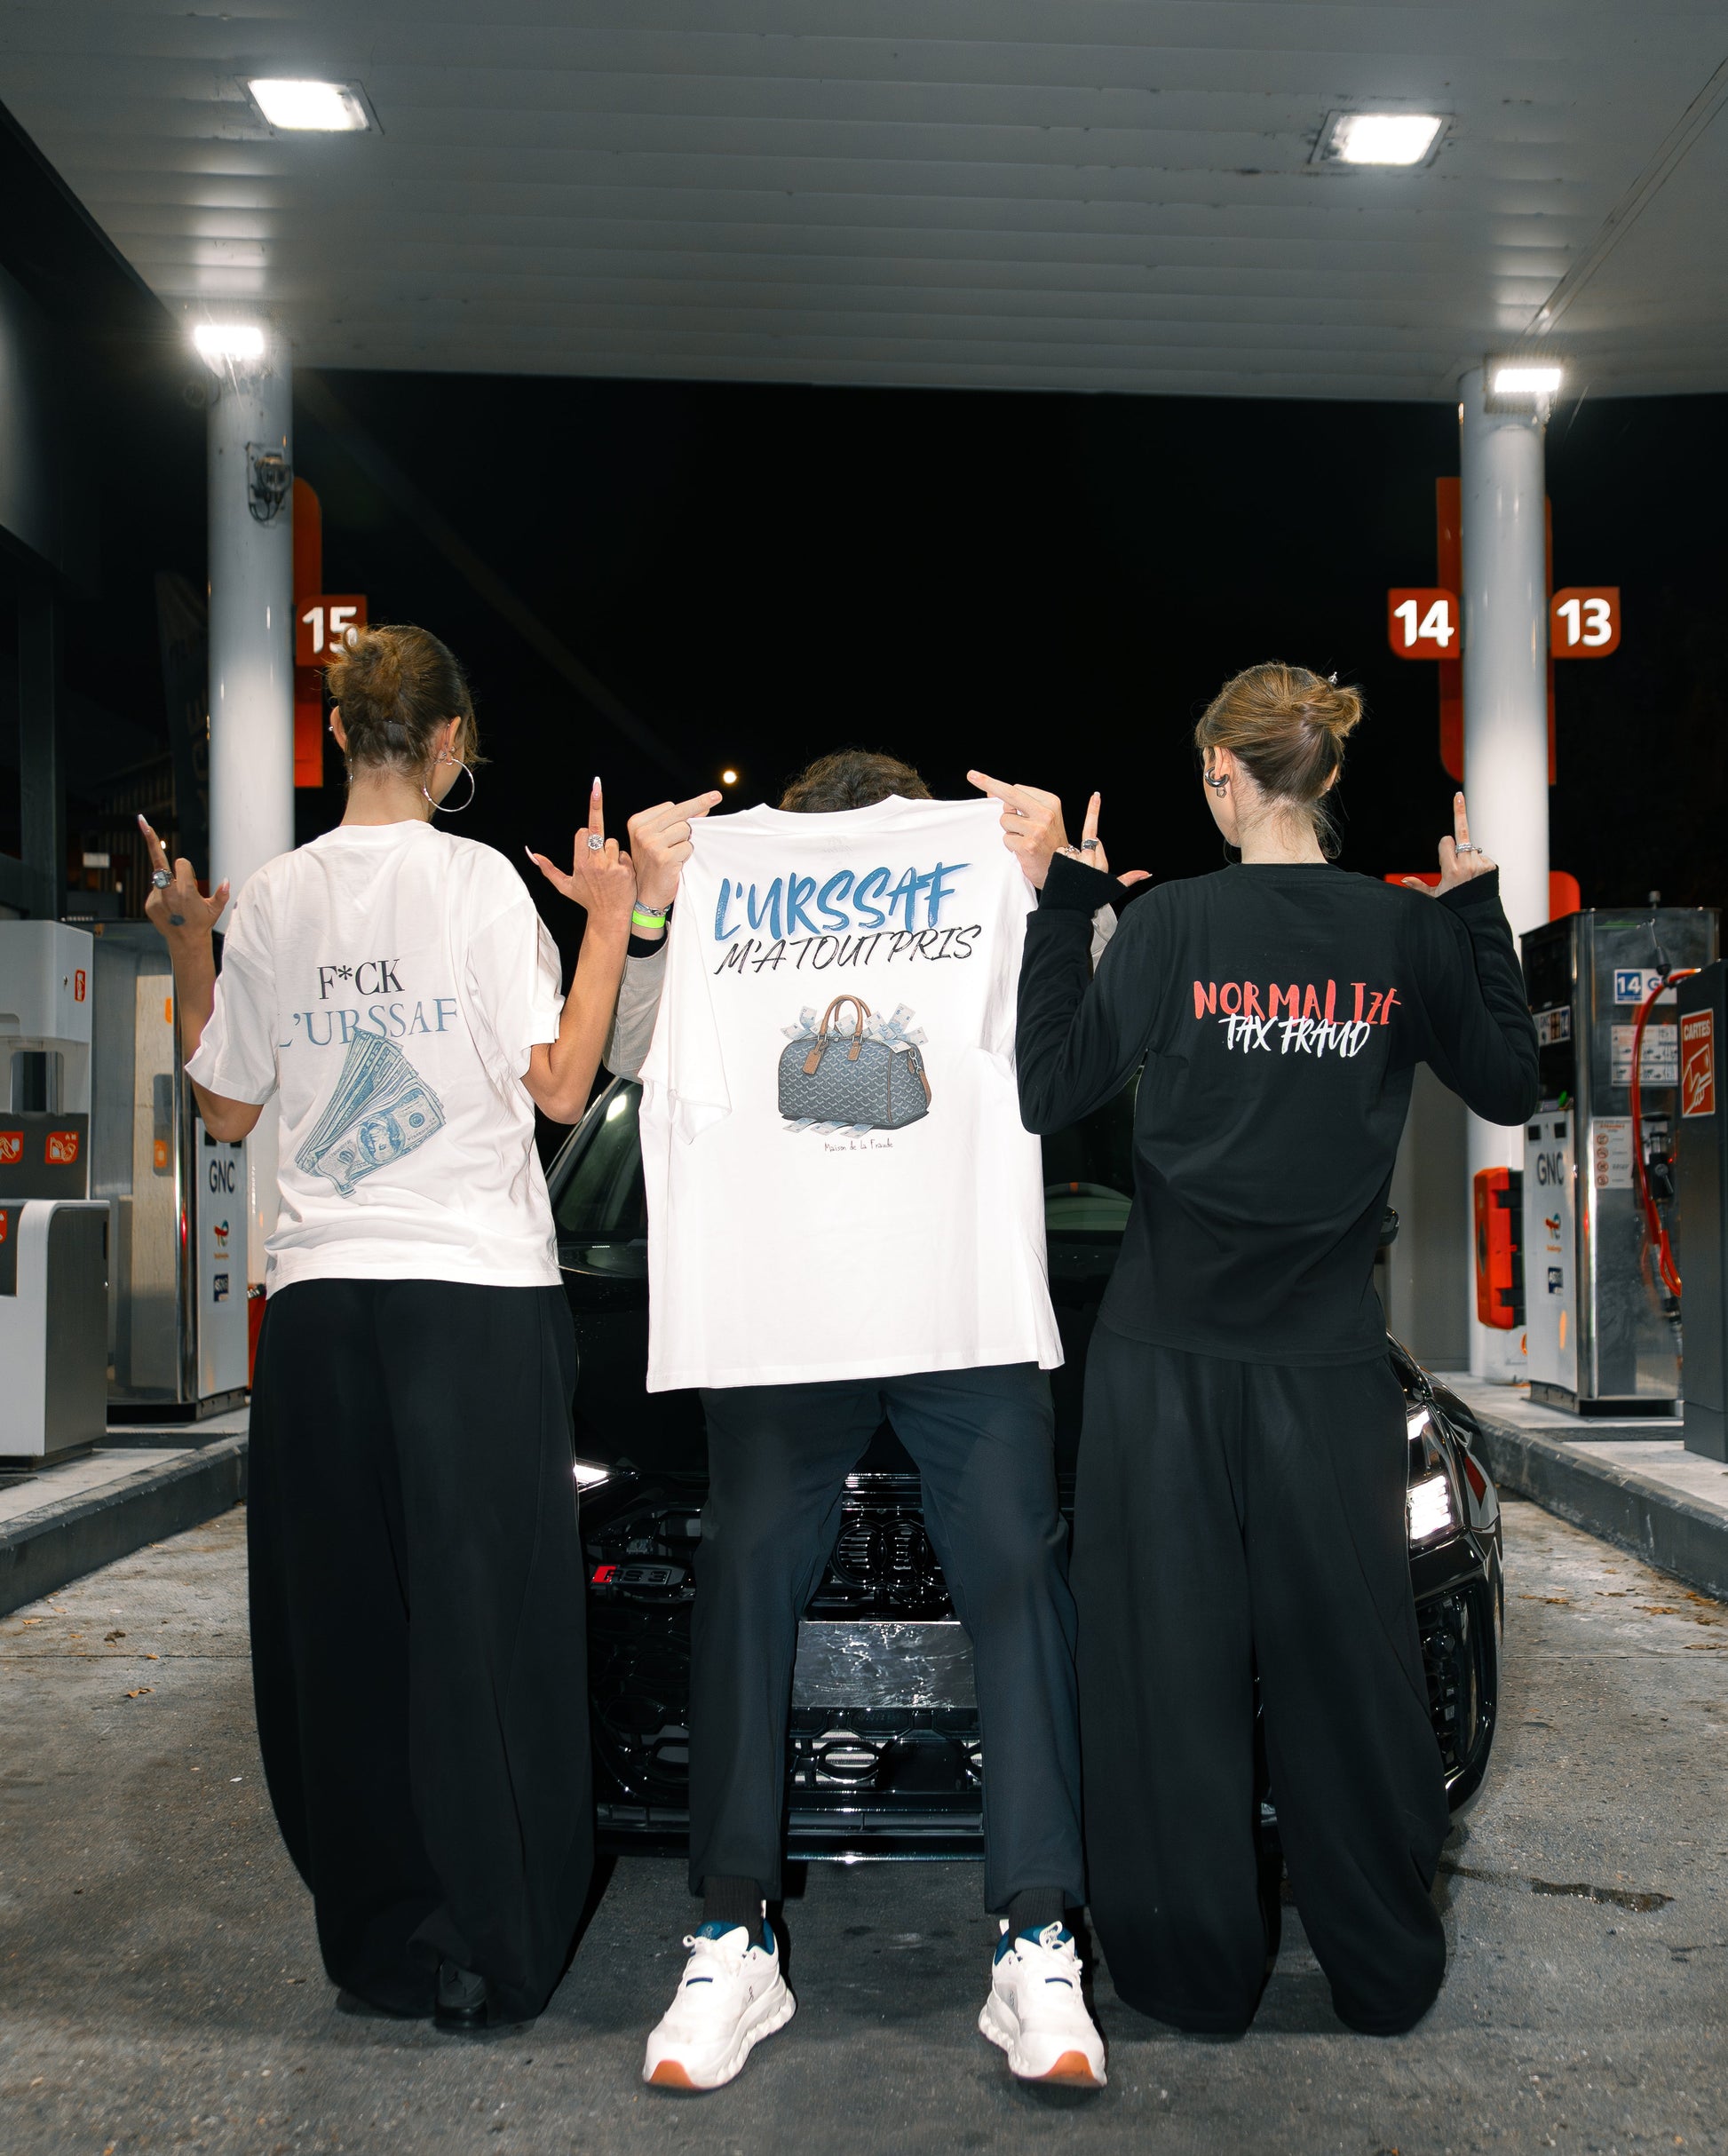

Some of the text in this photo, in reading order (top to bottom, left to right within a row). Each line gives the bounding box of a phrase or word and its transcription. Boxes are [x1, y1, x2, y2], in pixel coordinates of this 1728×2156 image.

[302, 606, 357, 654] 15
[1393, 599, 1455, 648] 14
[1557, 598, 1613, 647] 13
[714, 862, 973, 941] L'URSSAF
[713, 924, 982, 975] M'A TOUT PRIS
[1618, 975, 1642, 995] 14
[1217, 1013, 1371, 1058] TAX FRAUD
[1684, 1019, 1711, 1042] CARTES
[209, 1158, 235, 1194] GNC
[1537, 1151, 1565, 1186] GNC
[603, 1568, 644, 1582] RS
